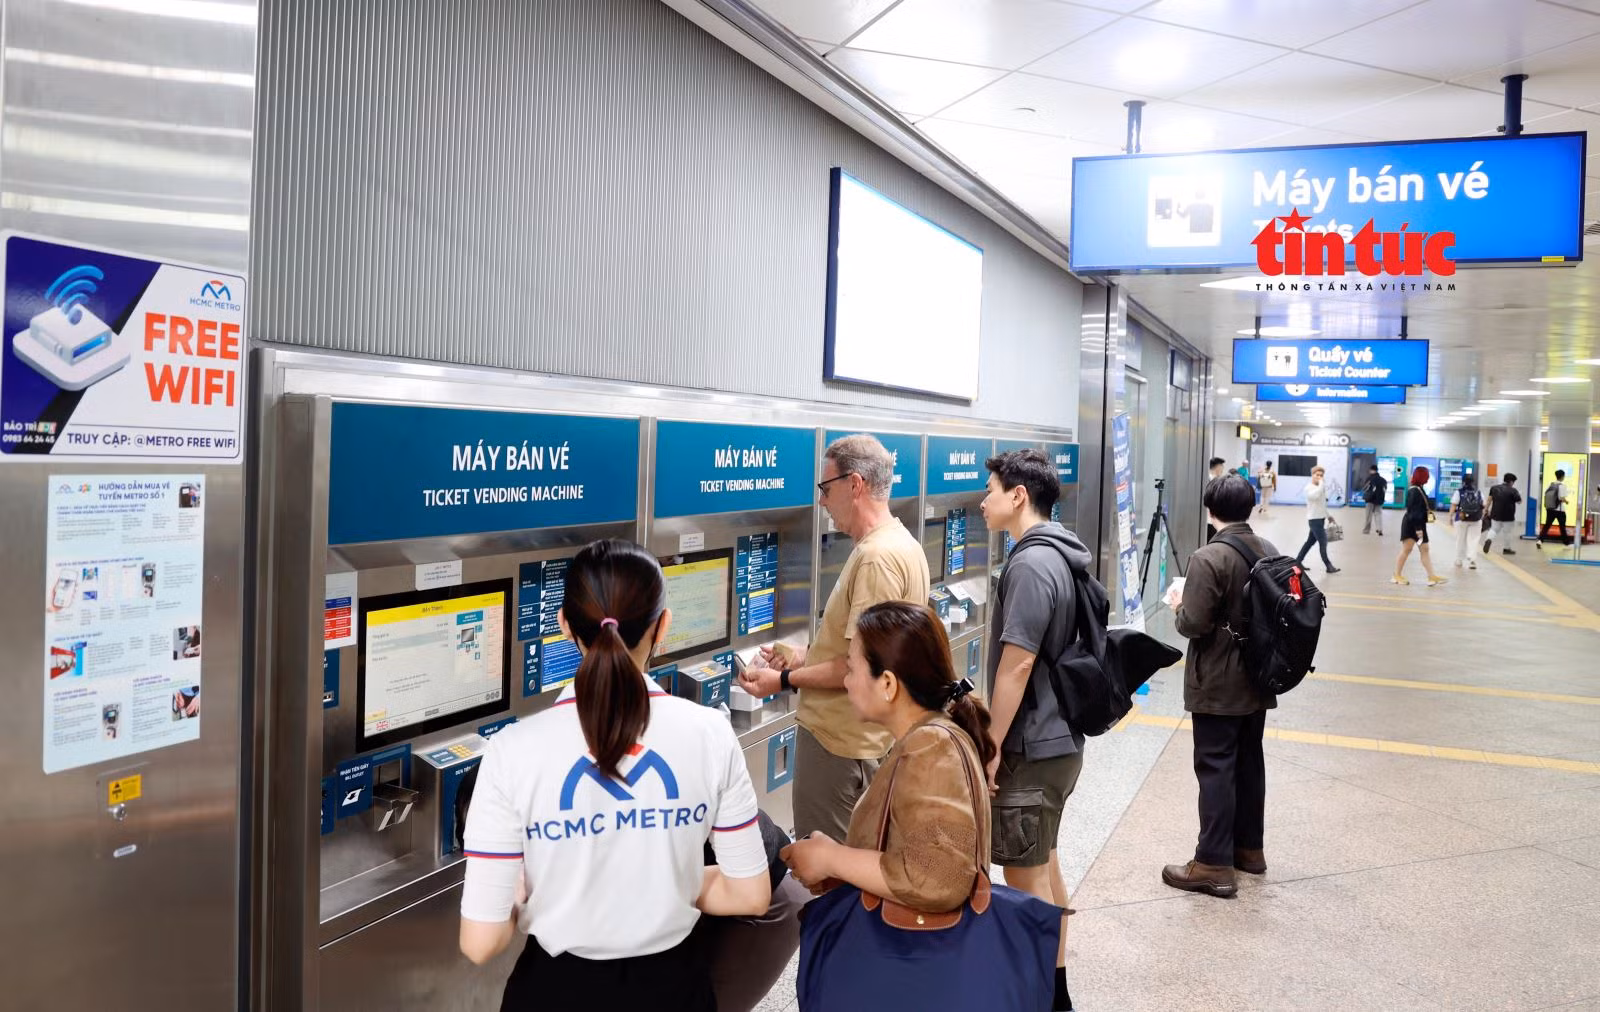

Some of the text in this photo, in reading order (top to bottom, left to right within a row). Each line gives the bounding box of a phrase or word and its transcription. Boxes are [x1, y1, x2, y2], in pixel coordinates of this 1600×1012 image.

[1253, 160, 1489, 214] Máy bán vé
[190, 298, 241, 312] HCMC METRO
[143, 312, 240, 360] FREE
[1353, 347, 1373, 363] vé
[1309, 365, 1391, 379] Ticket Counter
[144, 363, 236, 407] WIFI
[3, 419, 23, 432] BẢO
[24, 421, 37, 432] TRÌ
[67, 433, 98, 446] TRUY
[103, 429, 131, 449] CẬP:
[187, 437, 212, 448] FREE
[214, 437, 236, 449] WIFI
[452, 439, 570, 471] MÁY BÁN VÉ
[715, 444, 777, 468] MÁY BÁN VÉ
[98, 482, 126, 491] HƯỚNG
[128, 480, 143, 490] DẪN
[144, 482, 160, 490] MUA
[98, 491, 122, 500] TUYẾN
[150, 491, 160, 499] SỐ
[700, 478, 784, 493] TICKET VENDING MACHINE
[423, 485, 584, 507] TICKET VENDING MACHINE
[525, 803, 708, 841] HCMC METRO
